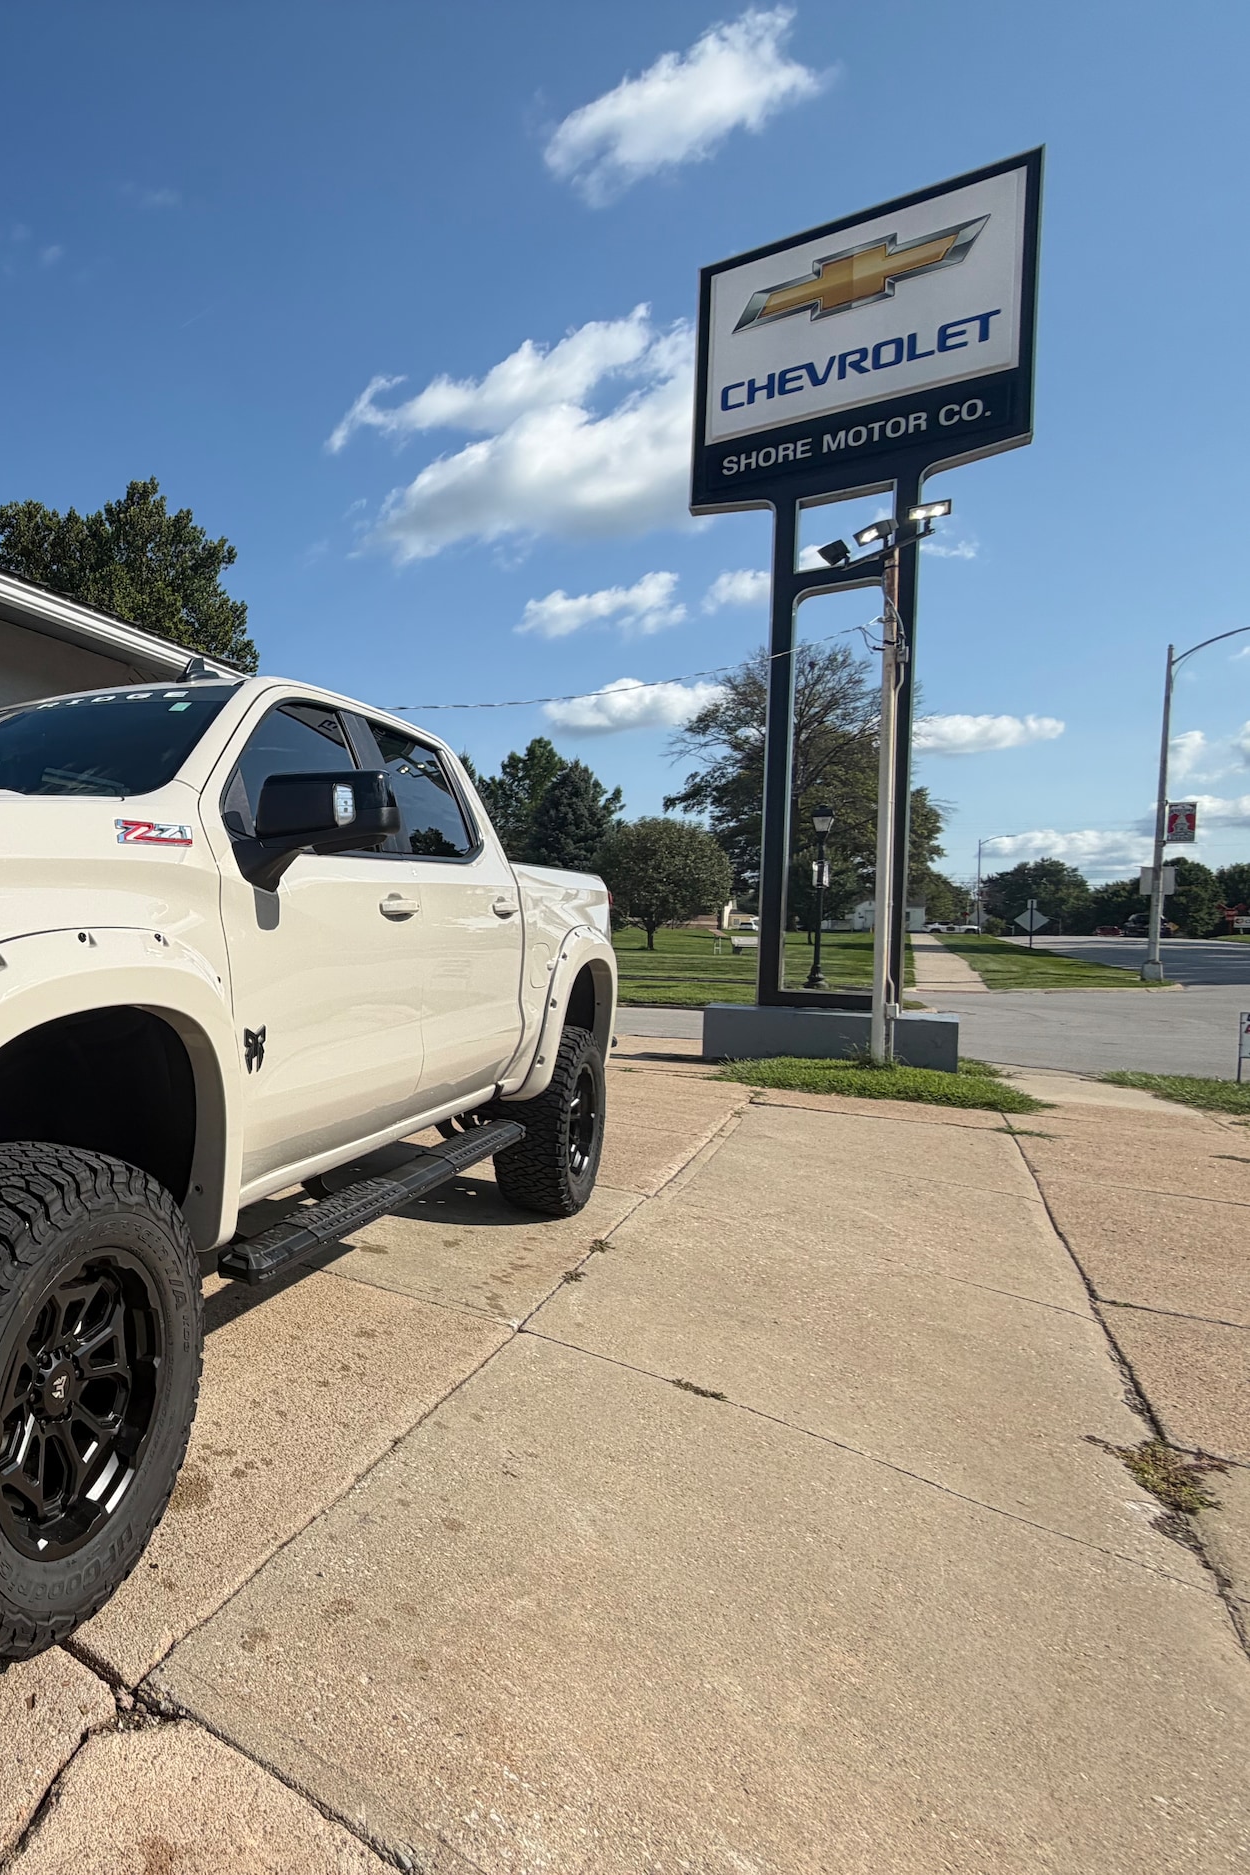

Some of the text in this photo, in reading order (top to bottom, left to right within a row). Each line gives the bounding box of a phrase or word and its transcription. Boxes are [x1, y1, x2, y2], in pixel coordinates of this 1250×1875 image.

[721, 308, 1001, 412] CHEVROLET
[721, 398, 992, 476] SHORE MOTOR CO.
[114, 818, 193, 847] Z71
